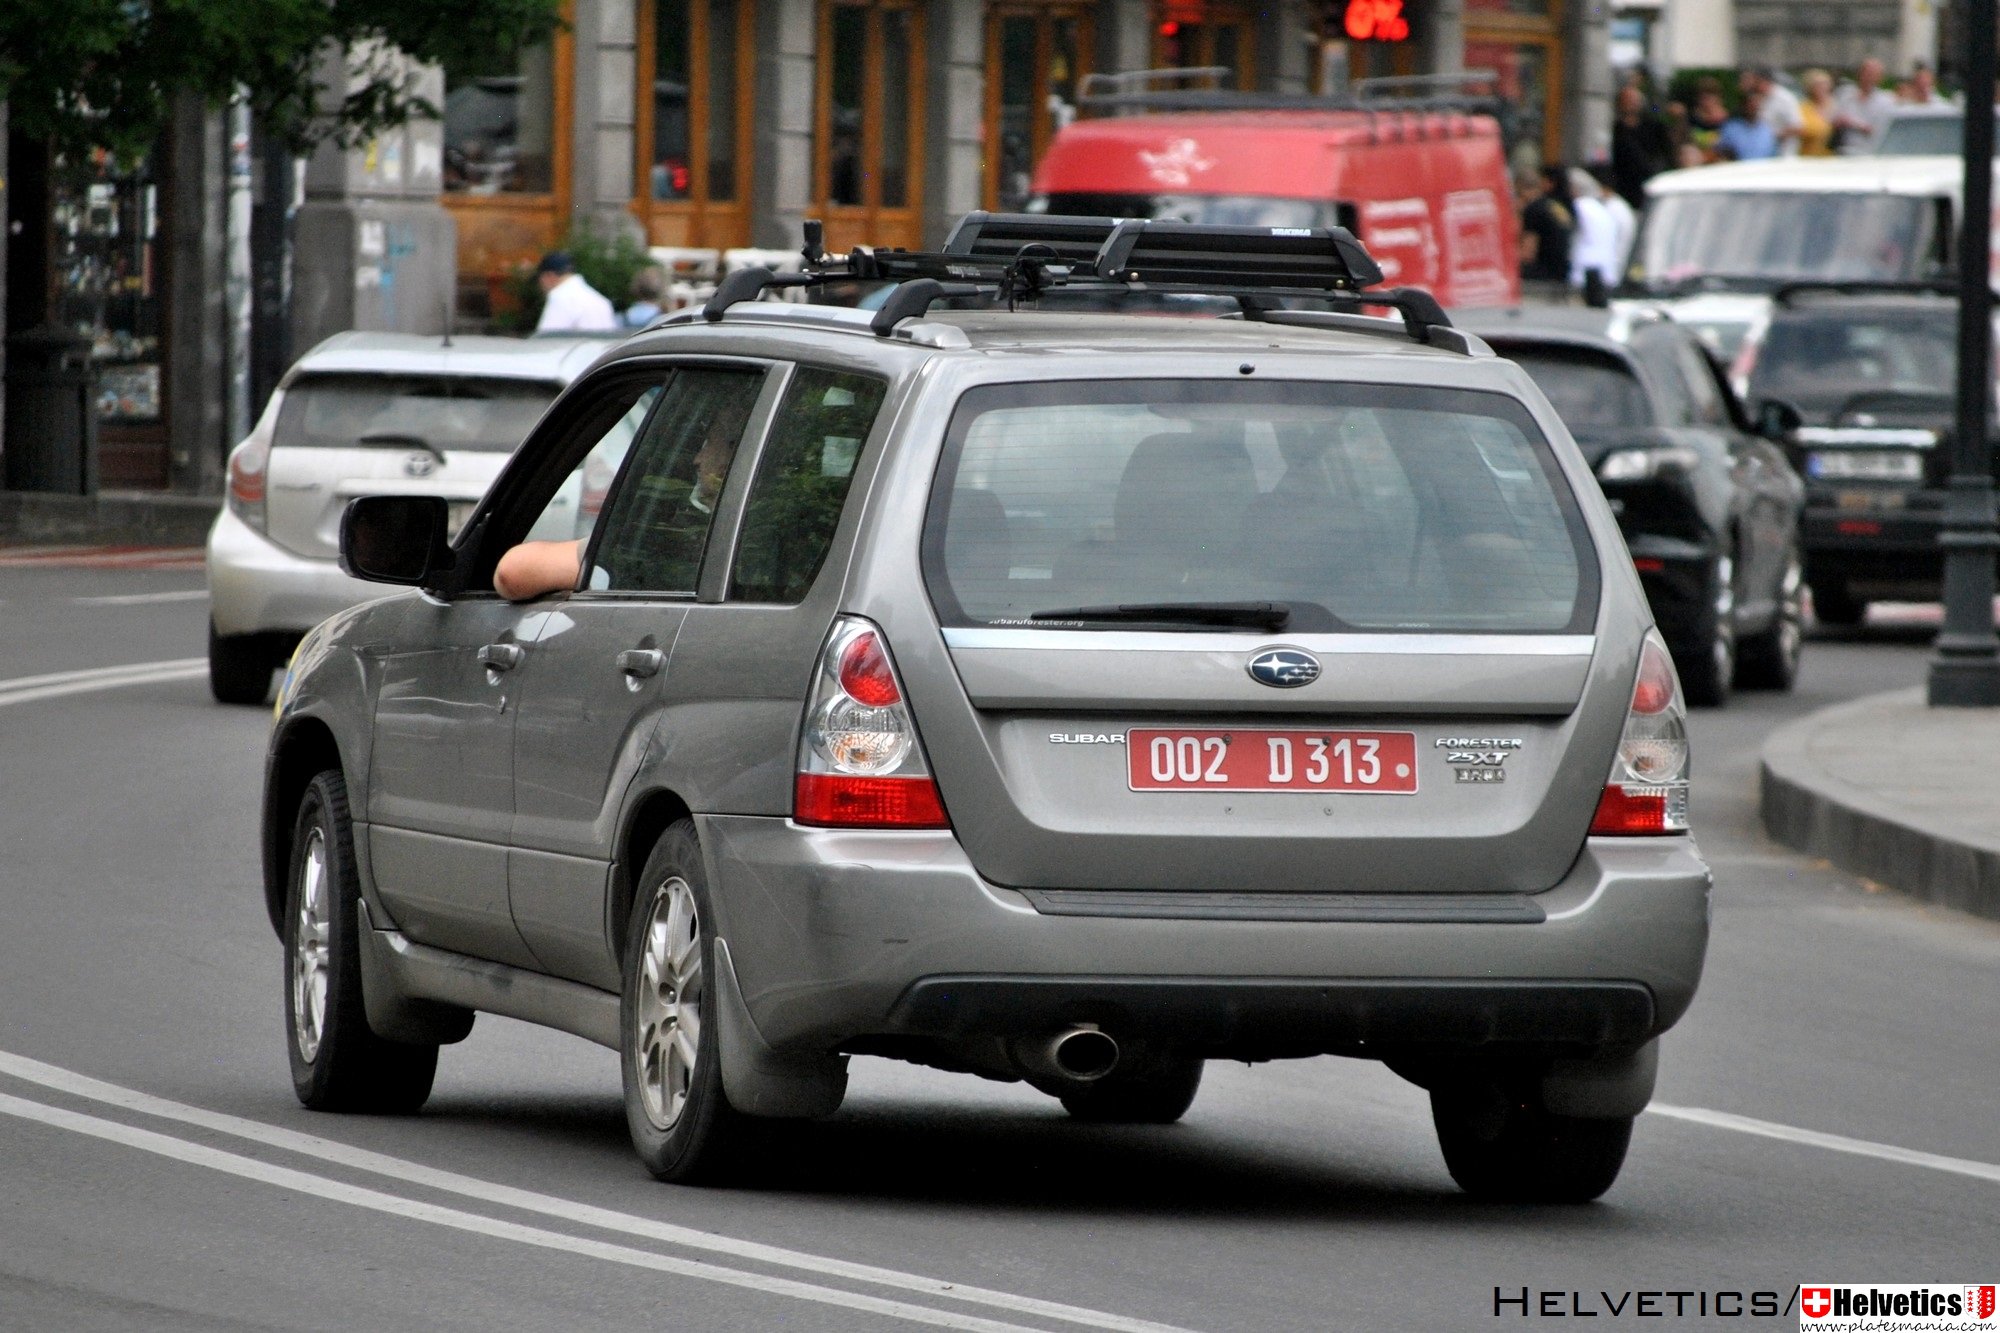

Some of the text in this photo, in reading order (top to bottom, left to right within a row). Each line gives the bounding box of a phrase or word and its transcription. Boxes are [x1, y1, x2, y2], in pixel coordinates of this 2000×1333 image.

[1049, 733, 1125, 744] SUBAR
[1435, 738, 1522, 748] FORESTER
[1151, 737, 1381, 784] 002 D 313
[1446, 752, 1508, 765] 25XT
